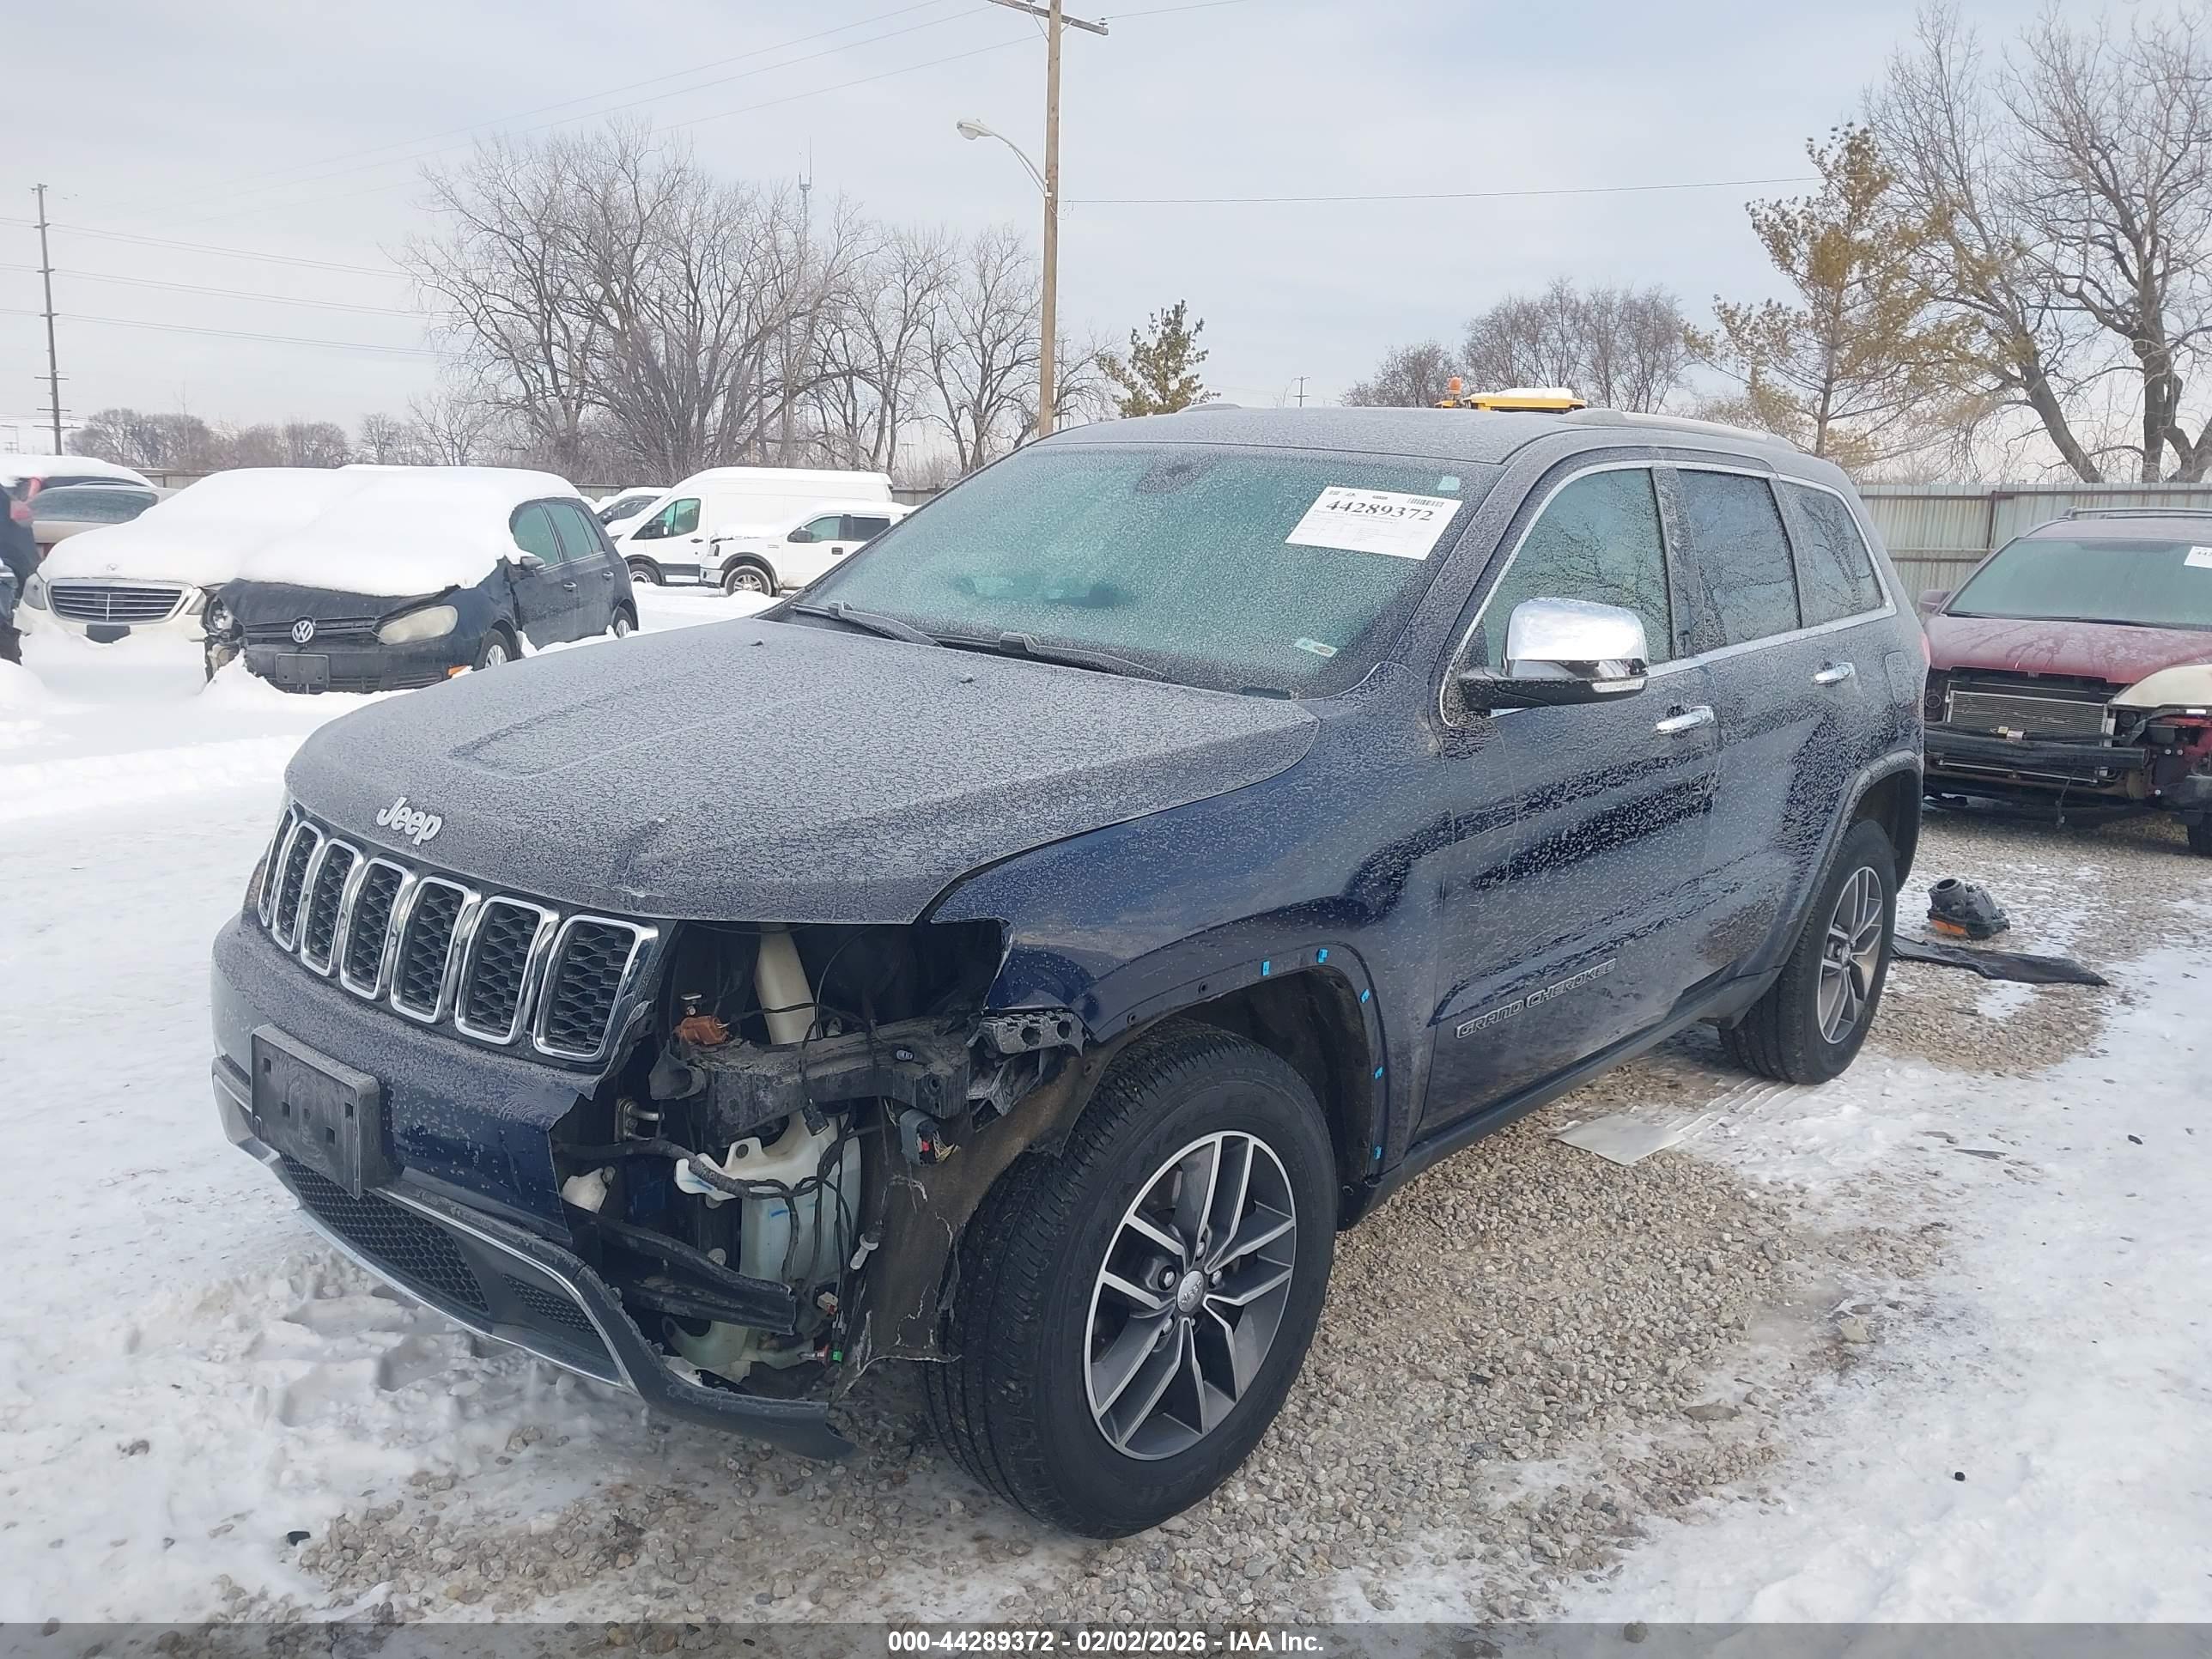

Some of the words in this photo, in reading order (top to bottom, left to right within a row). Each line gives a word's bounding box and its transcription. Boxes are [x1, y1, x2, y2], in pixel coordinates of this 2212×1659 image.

[1325, 500, 1435, 521] 44289372
[292, 620, 313, 643] VW
[376, 796, 442, 846] Jeep
[1456, 1000, 1524, 1039] GRAND
[1526, 957, 1617, 1008] CHEROKEE
